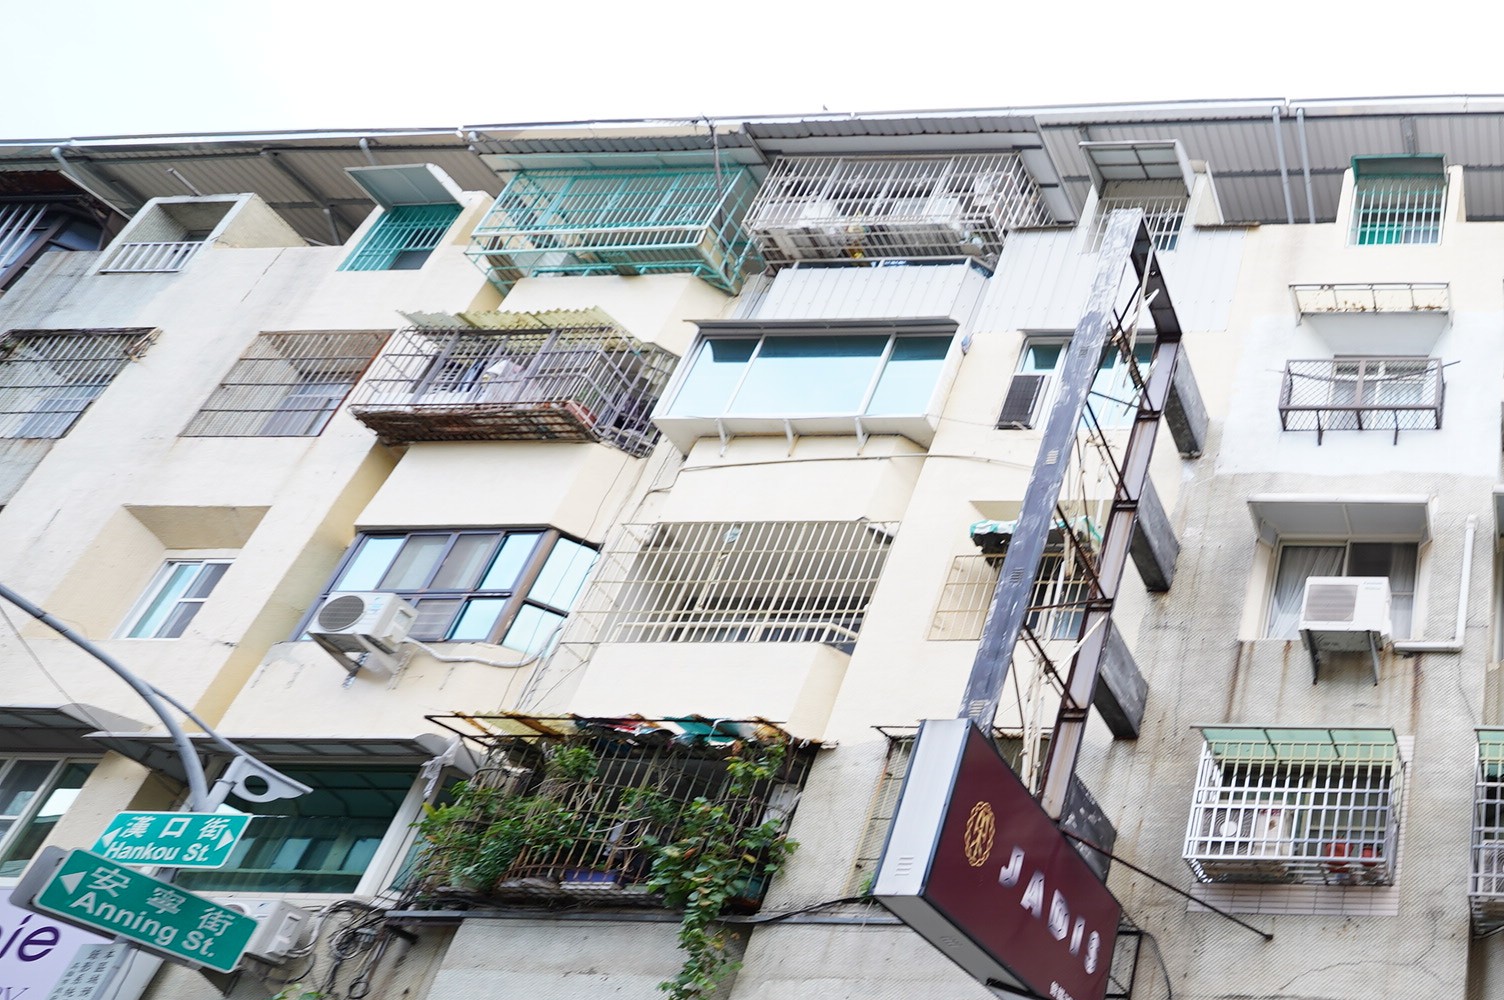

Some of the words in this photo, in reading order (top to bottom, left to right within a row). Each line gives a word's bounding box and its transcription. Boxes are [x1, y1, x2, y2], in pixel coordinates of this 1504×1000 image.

[102, 840, 182, 862] Hankou
[181, 842, 211, 862] St.
[119, 816, 231, 841] 漢口街
[69, 891, 179, 946] Anning
[182, 930, 217, 958] St.
[87, 866, 236, 937] 安寧街
[998, 845, 1101, 975] JADIS
